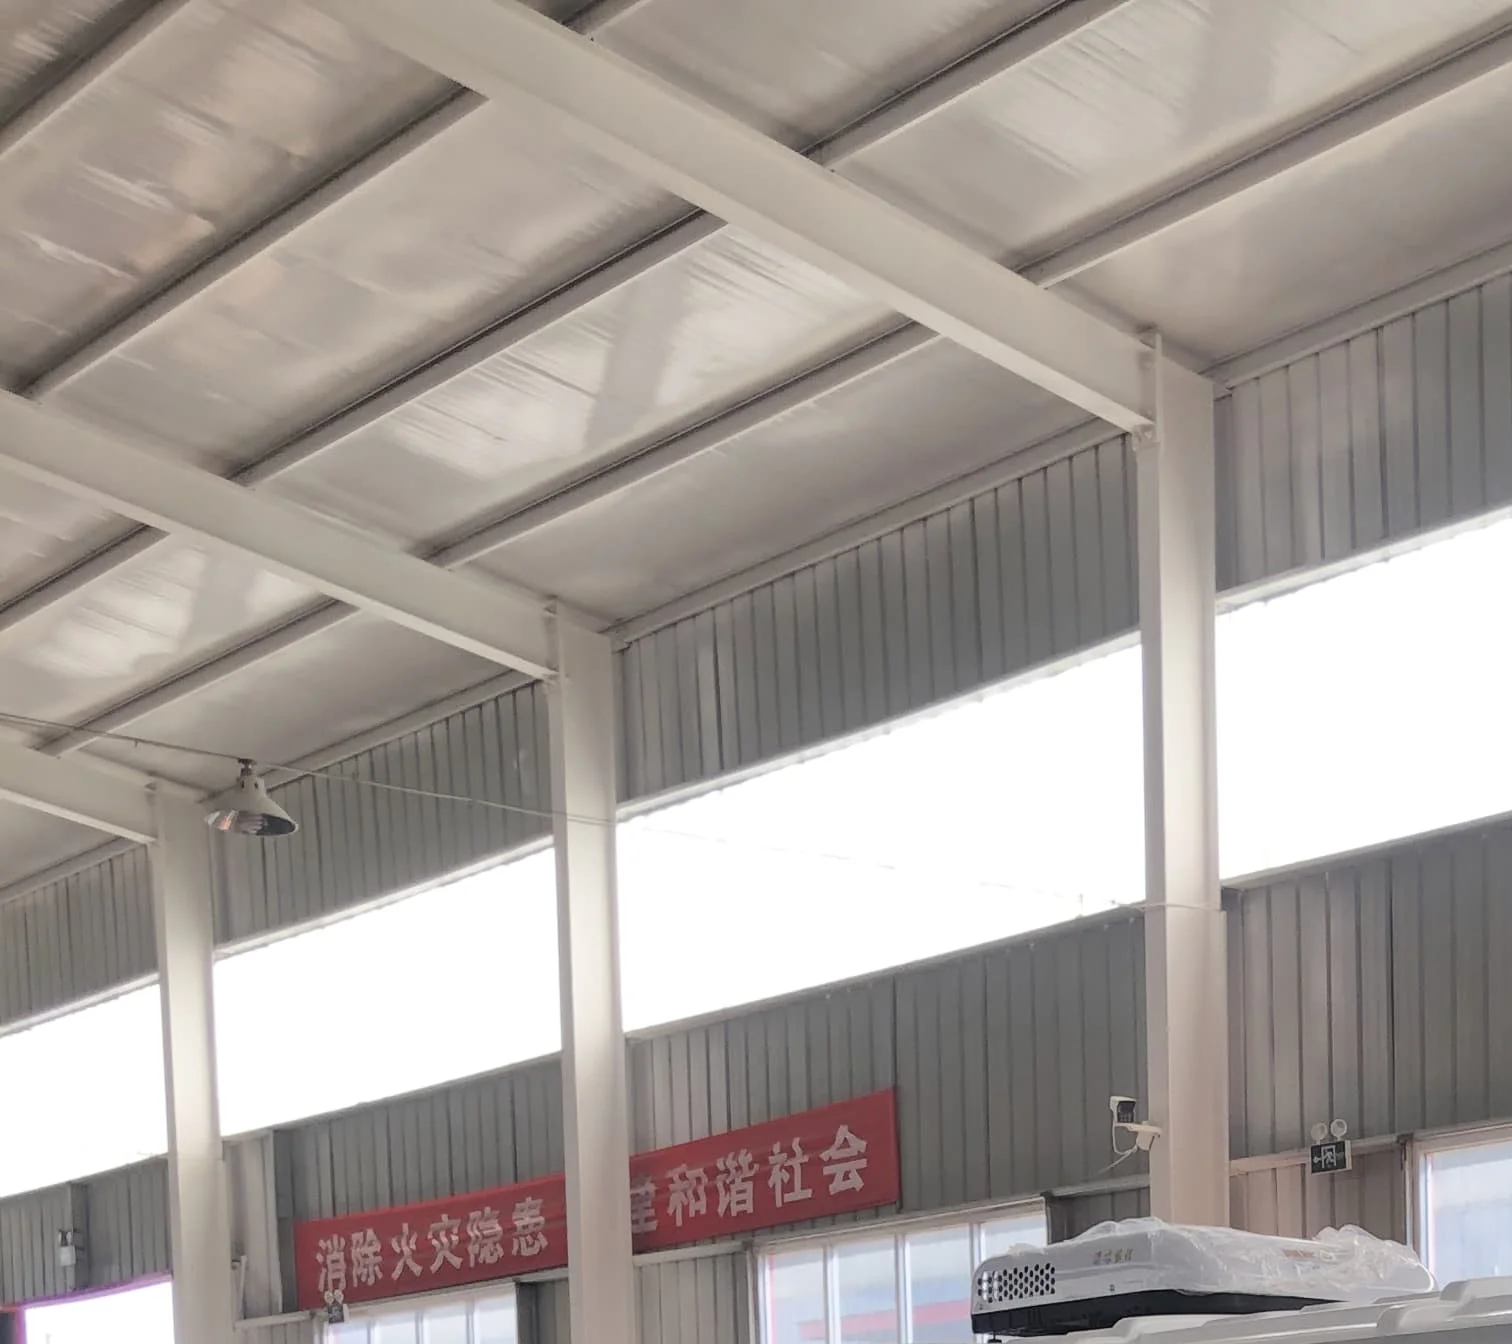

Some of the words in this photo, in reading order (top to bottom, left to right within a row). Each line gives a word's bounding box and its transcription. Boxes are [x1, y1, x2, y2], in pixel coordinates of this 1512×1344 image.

[316, 1196, 548, 1291] 消除火灾隐患
